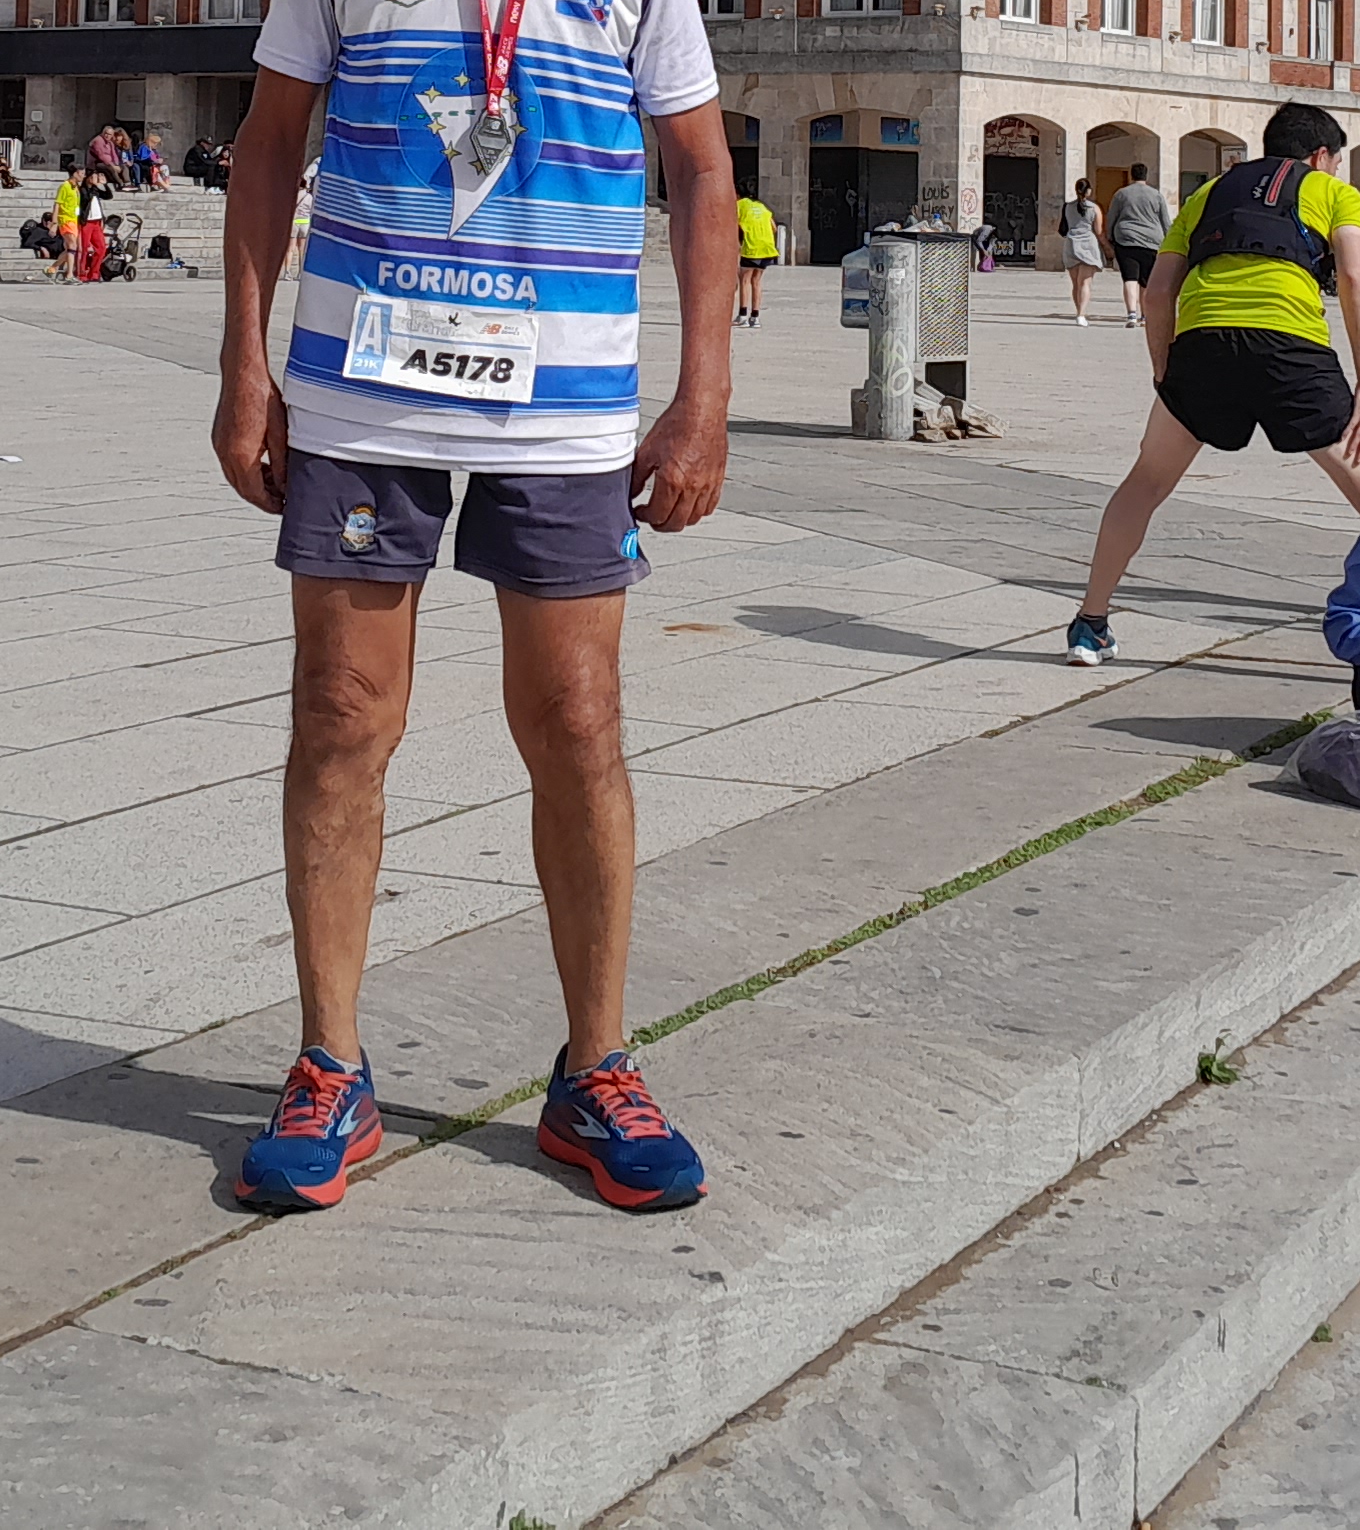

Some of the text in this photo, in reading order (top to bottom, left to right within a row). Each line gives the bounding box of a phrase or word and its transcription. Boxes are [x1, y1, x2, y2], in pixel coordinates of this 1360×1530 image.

[509, 1, 522, 24] new
[378, 260, 537, 303] FORMOSA
[356, 306, 383, 355] A
[354, 357, 379, 370] 21K
[400, 348, 515, 383] A5178
